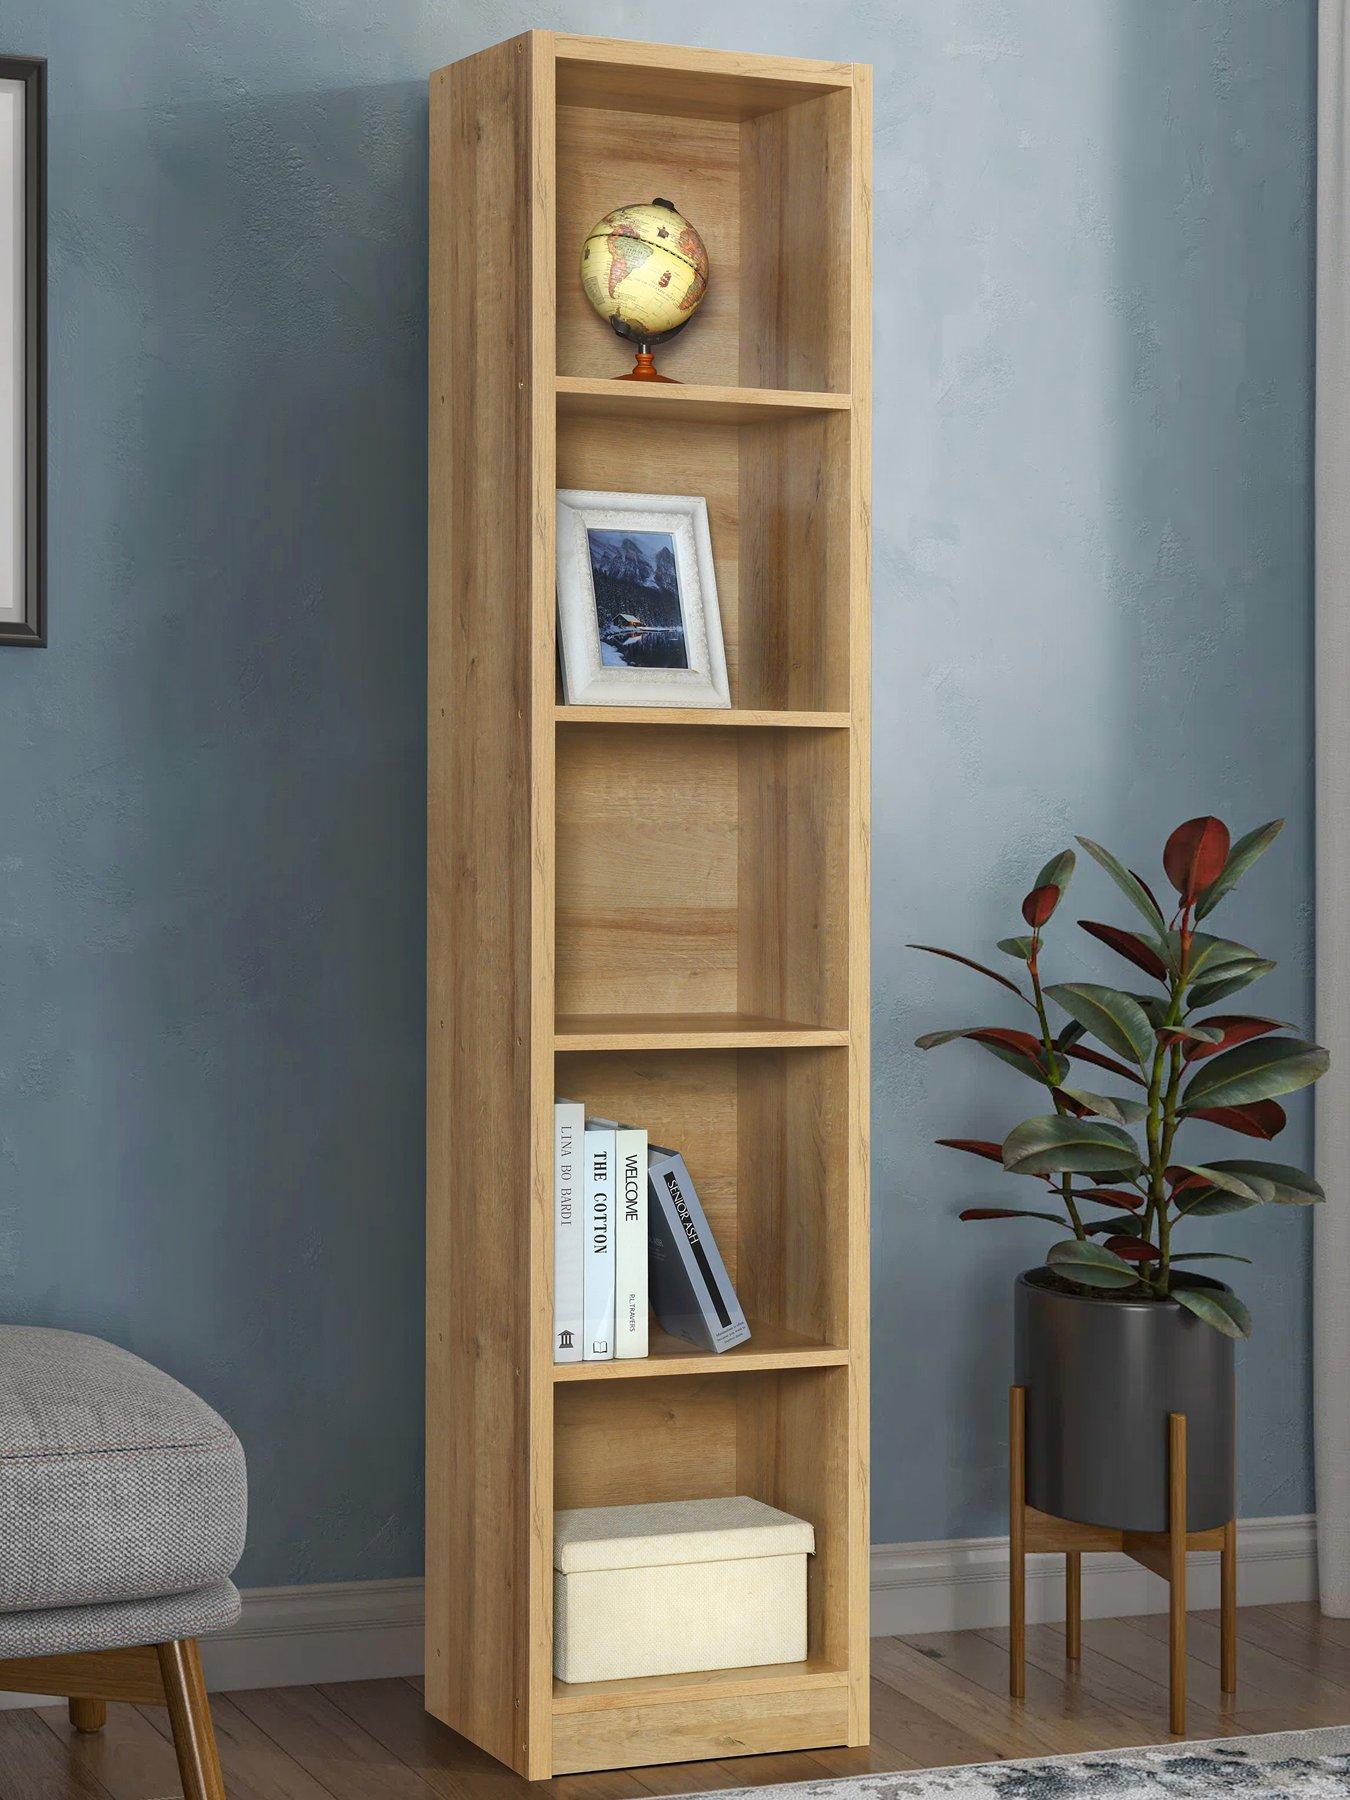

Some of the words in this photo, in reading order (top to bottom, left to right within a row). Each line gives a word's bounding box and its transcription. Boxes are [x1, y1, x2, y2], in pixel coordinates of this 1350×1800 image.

[561, 1126, 572, 1157] LINA
[560, 1164, 572, 1181] BO
[593, 1151, 608, 1182] THE
[560, 1188, 572, 1227] BARDI
[625, 1154, 639, 1222] WELCOME
[593, 1192, 608, 1254] COTTON
[667, 1179, 690, 1221] SENIOR
[683, 1222, 699, 1245] ASH
